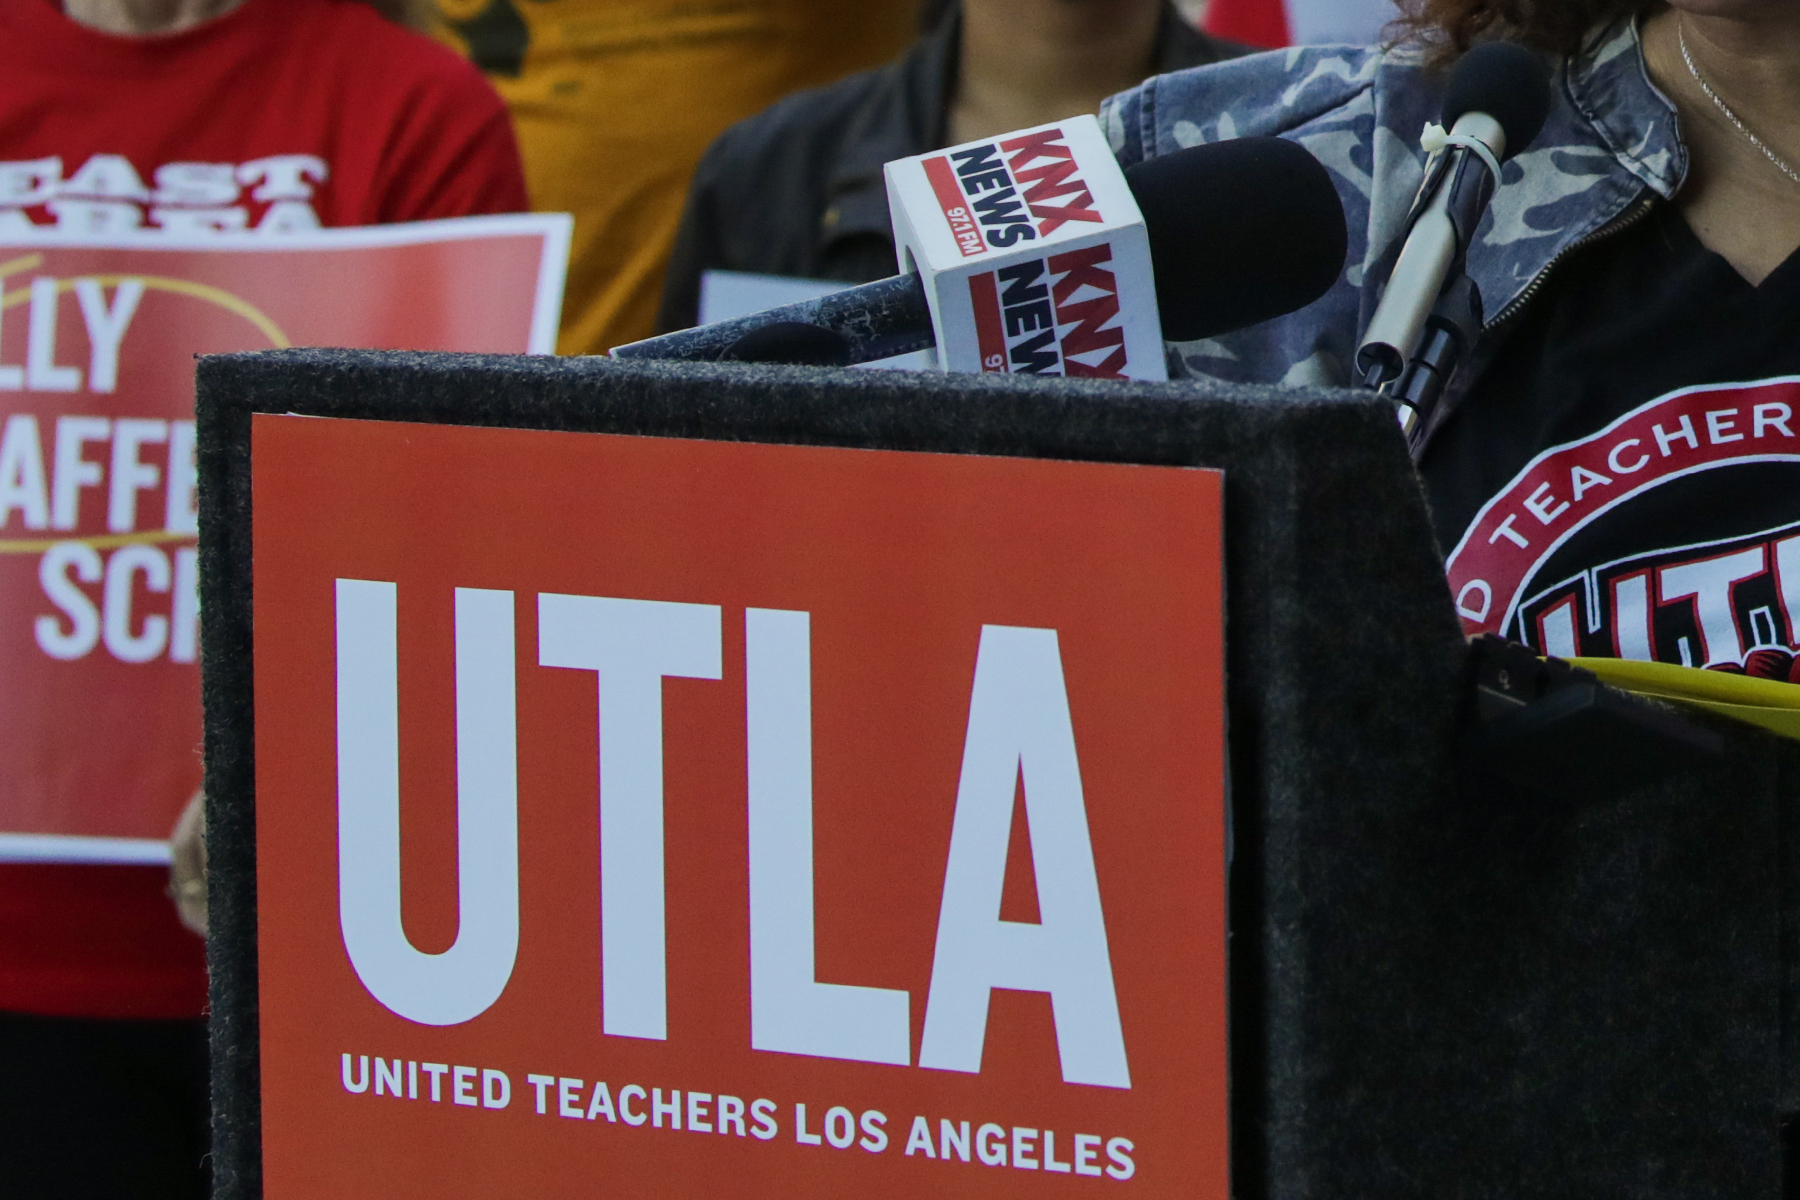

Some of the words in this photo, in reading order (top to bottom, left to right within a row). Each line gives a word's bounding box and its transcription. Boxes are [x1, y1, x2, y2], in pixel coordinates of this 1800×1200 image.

[947, 206, 969, 231] 97.1
[950, 144, 1036, 248] NEWS
[999, 128, 1104, 238] KNX
[954, 225, 983, 254] FM
[335, 577, 1131, 1089] UTLA
[341, 1052, 510, 1108] UNITED
[527, 1073, 777, 1141] TEACHERS
[795, 1103, 888, 1152] LOS
[905, 1115, 1136, 1181] ANGELES
